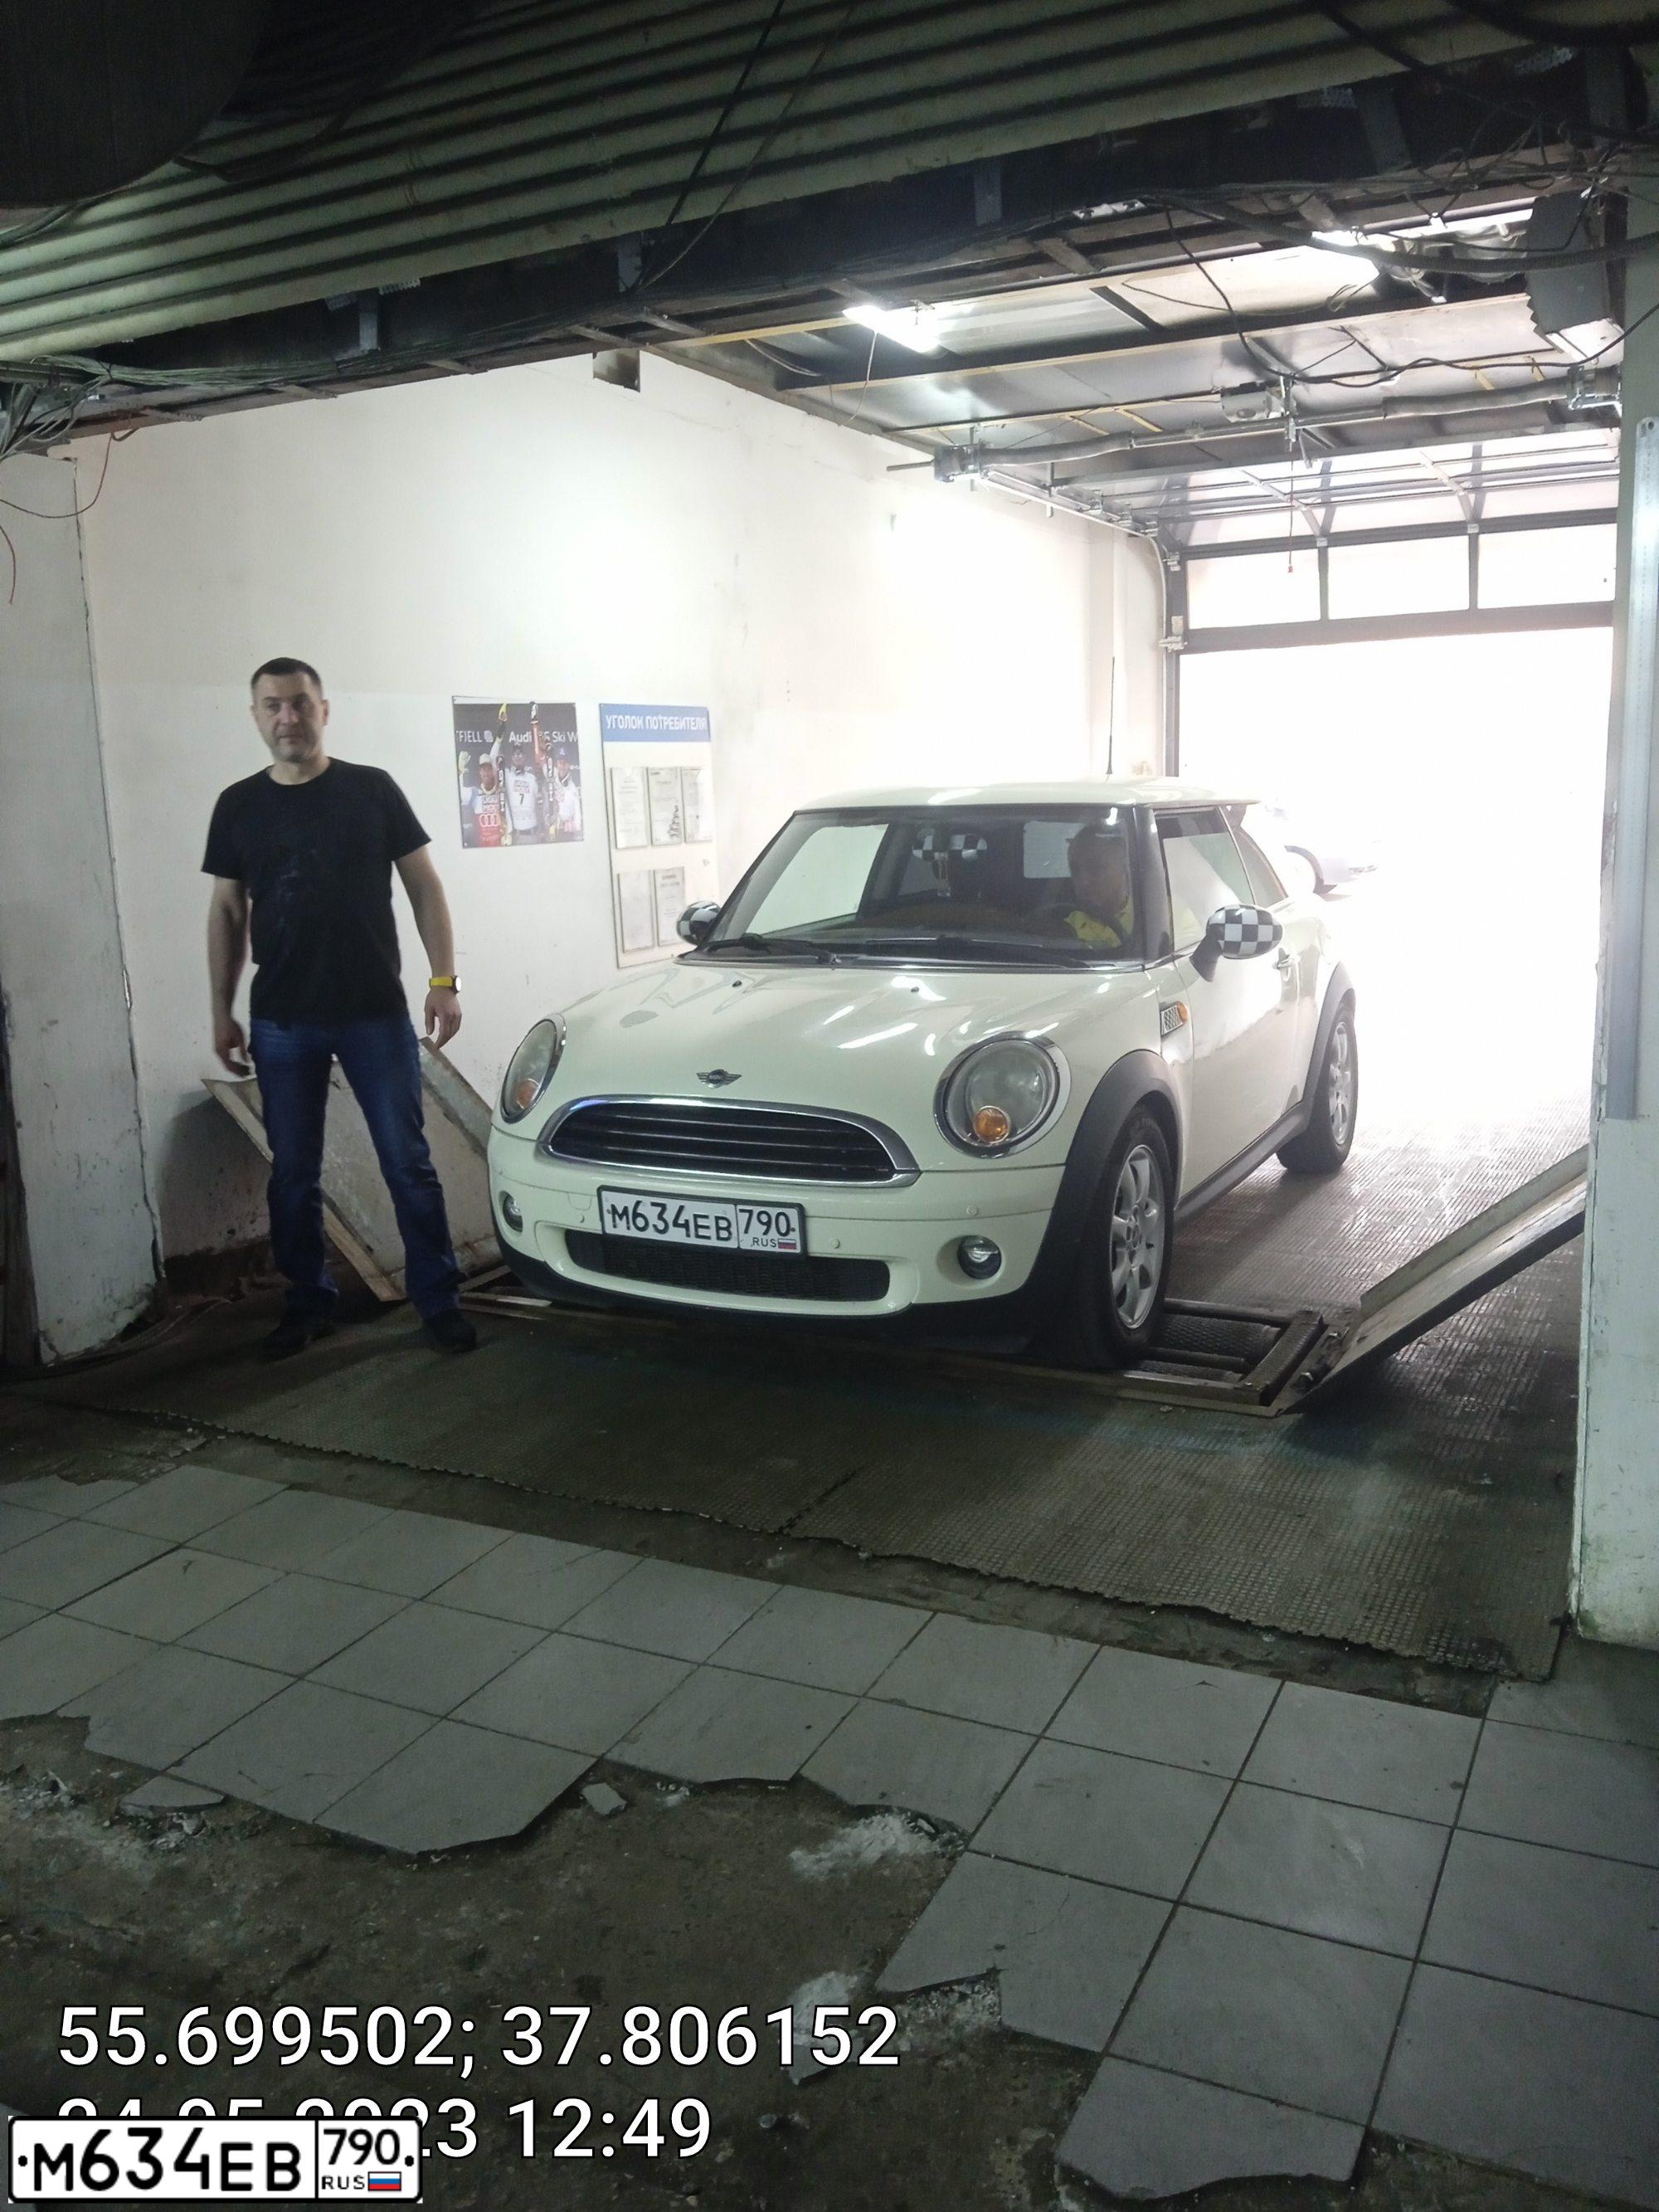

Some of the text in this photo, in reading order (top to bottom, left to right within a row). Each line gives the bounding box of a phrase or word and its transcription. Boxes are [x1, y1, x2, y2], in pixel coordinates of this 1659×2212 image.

[606, 714, 708, 731] УГОЛОК ПОТРЕБИТЕЛЯ
[456, 730, 482, 743] FJELL
[508, 731, 533, 743] Audi
[738, 1209, 791, 1237] 790
[752, 1236, 777, 1248] RUS
